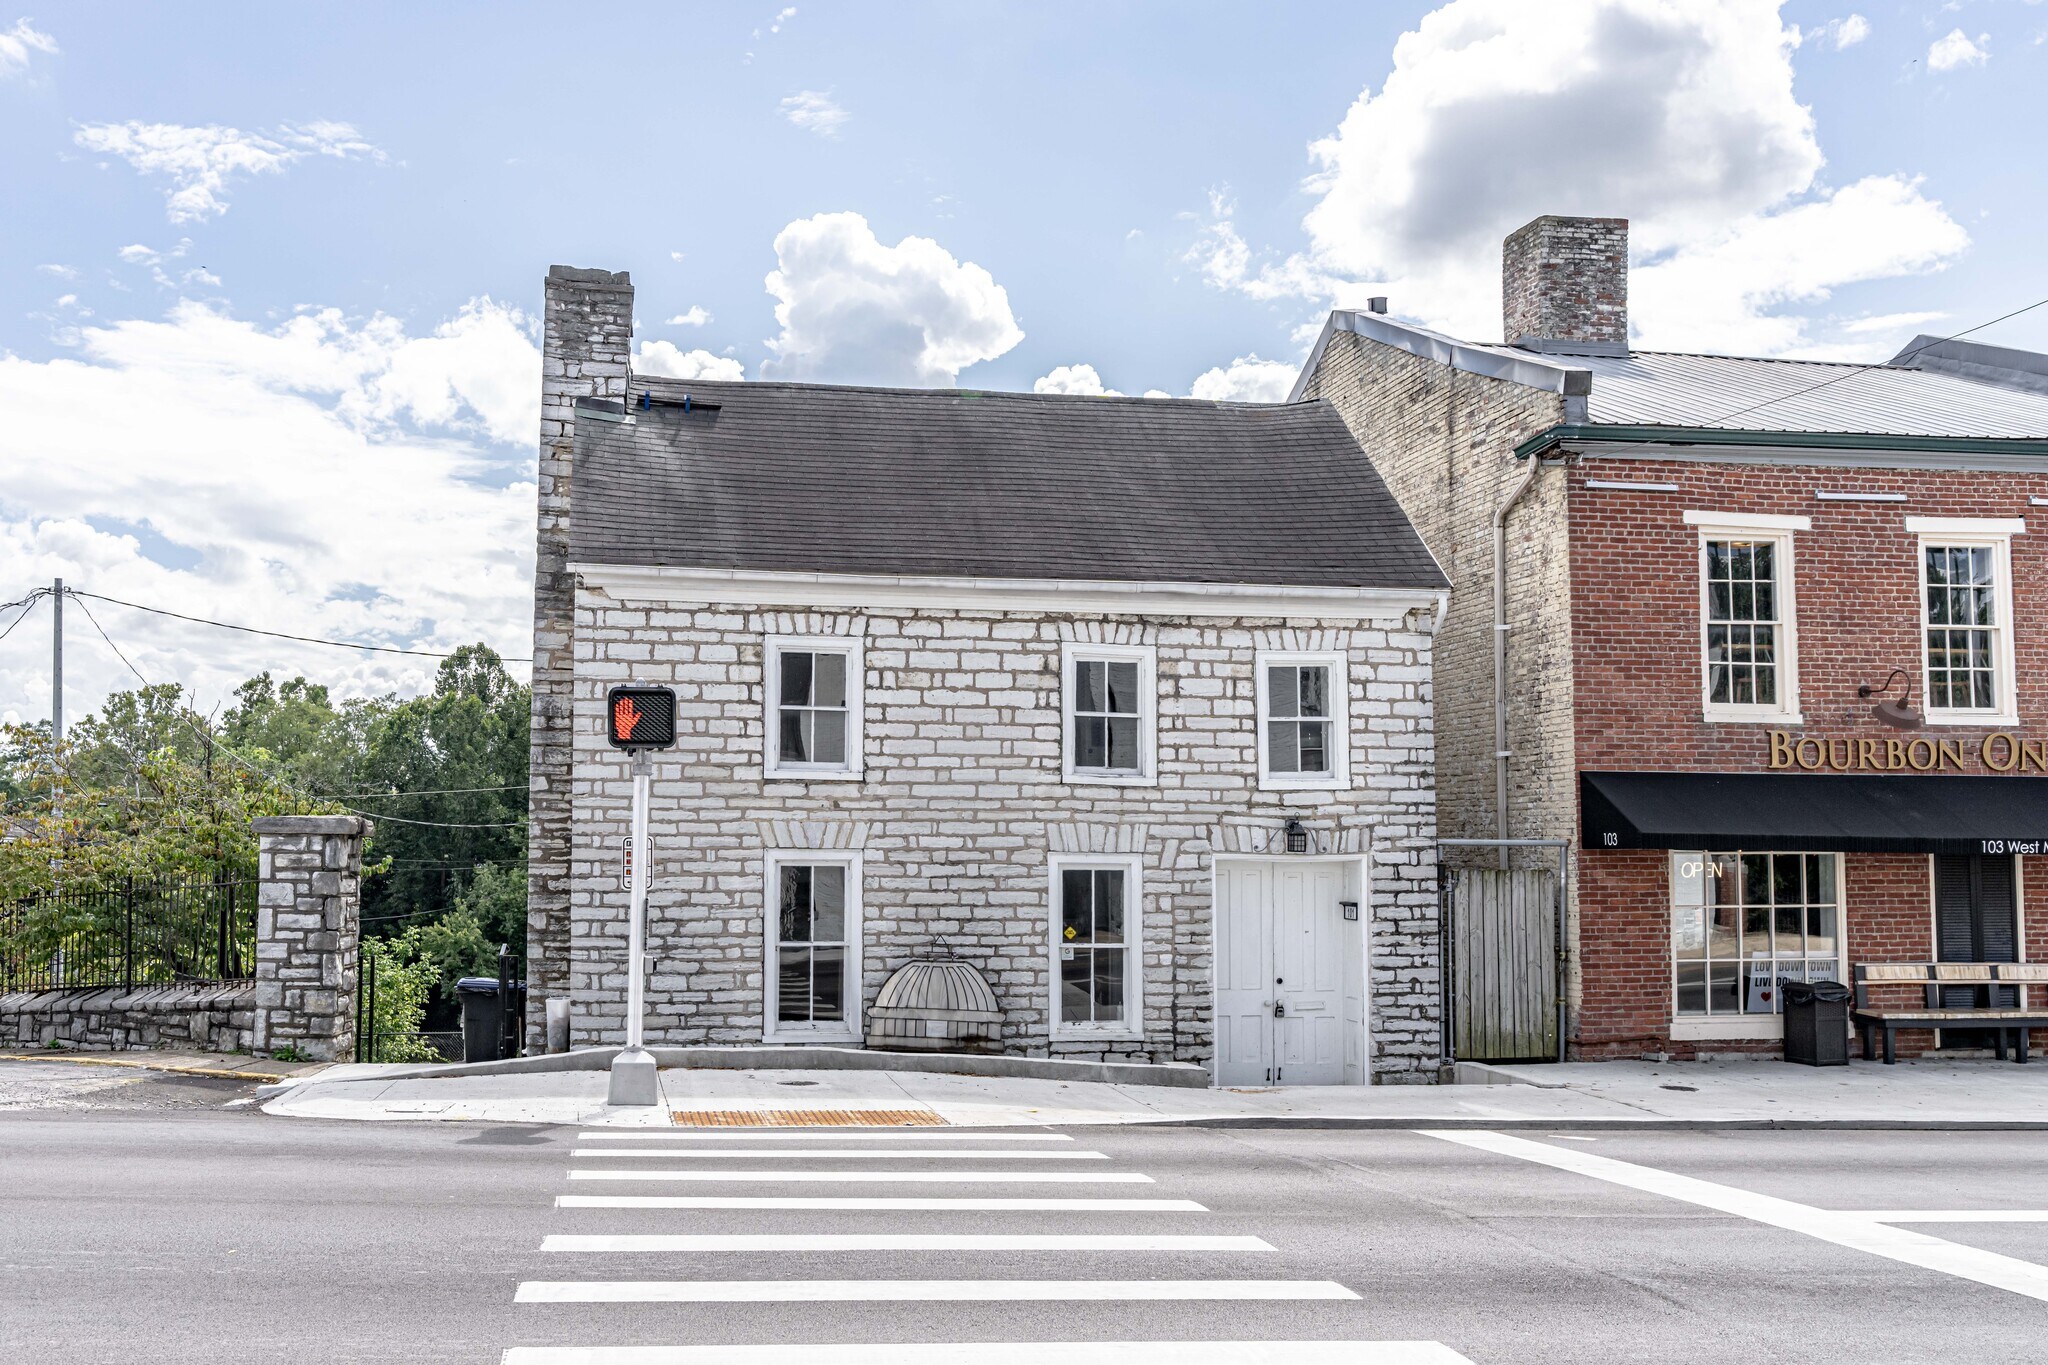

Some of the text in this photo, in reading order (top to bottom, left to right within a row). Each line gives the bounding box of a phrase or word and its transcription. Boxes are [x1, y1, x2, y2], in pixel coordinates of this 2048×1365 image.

[1765, 729, 1964, 771] BOURBON
[1603, 832, 1618, 846] 103
[1981, 840, 2004, 854] 103
[2007, 840, 2040, 854] West
[1681, 862, 1723, 878] OPEN
[1755, 961, 1773, 972] LOV
